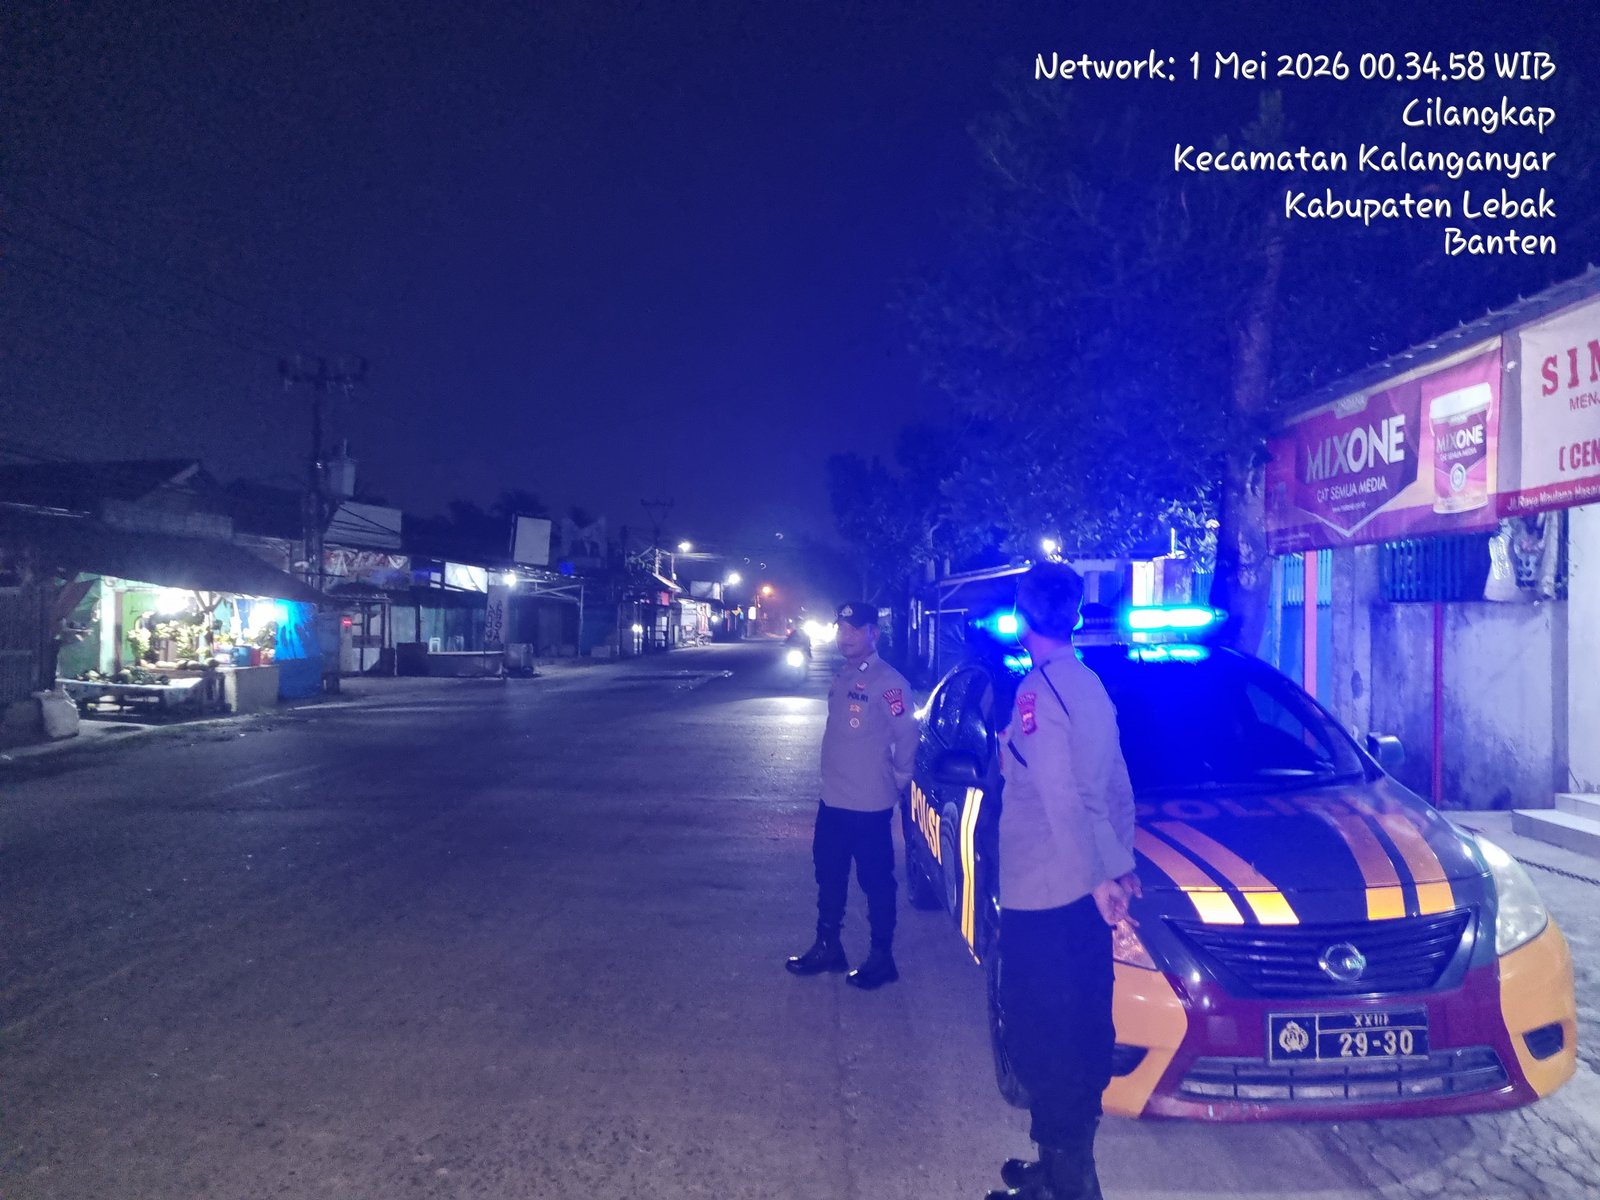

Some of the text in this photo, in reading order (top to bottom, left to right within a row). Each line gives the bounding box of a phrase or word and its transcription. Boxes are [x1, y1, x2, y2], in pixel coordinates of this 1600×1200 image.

[1305, 414, 1405, 484] MIXONE
[1435, 424, 1484, 454] MIXONE
[1359, 475, 1389, 494] MEDIA
[911, 779, 942, 866] POLISI
[1340, 1028, 1414, 1058] 29-30
